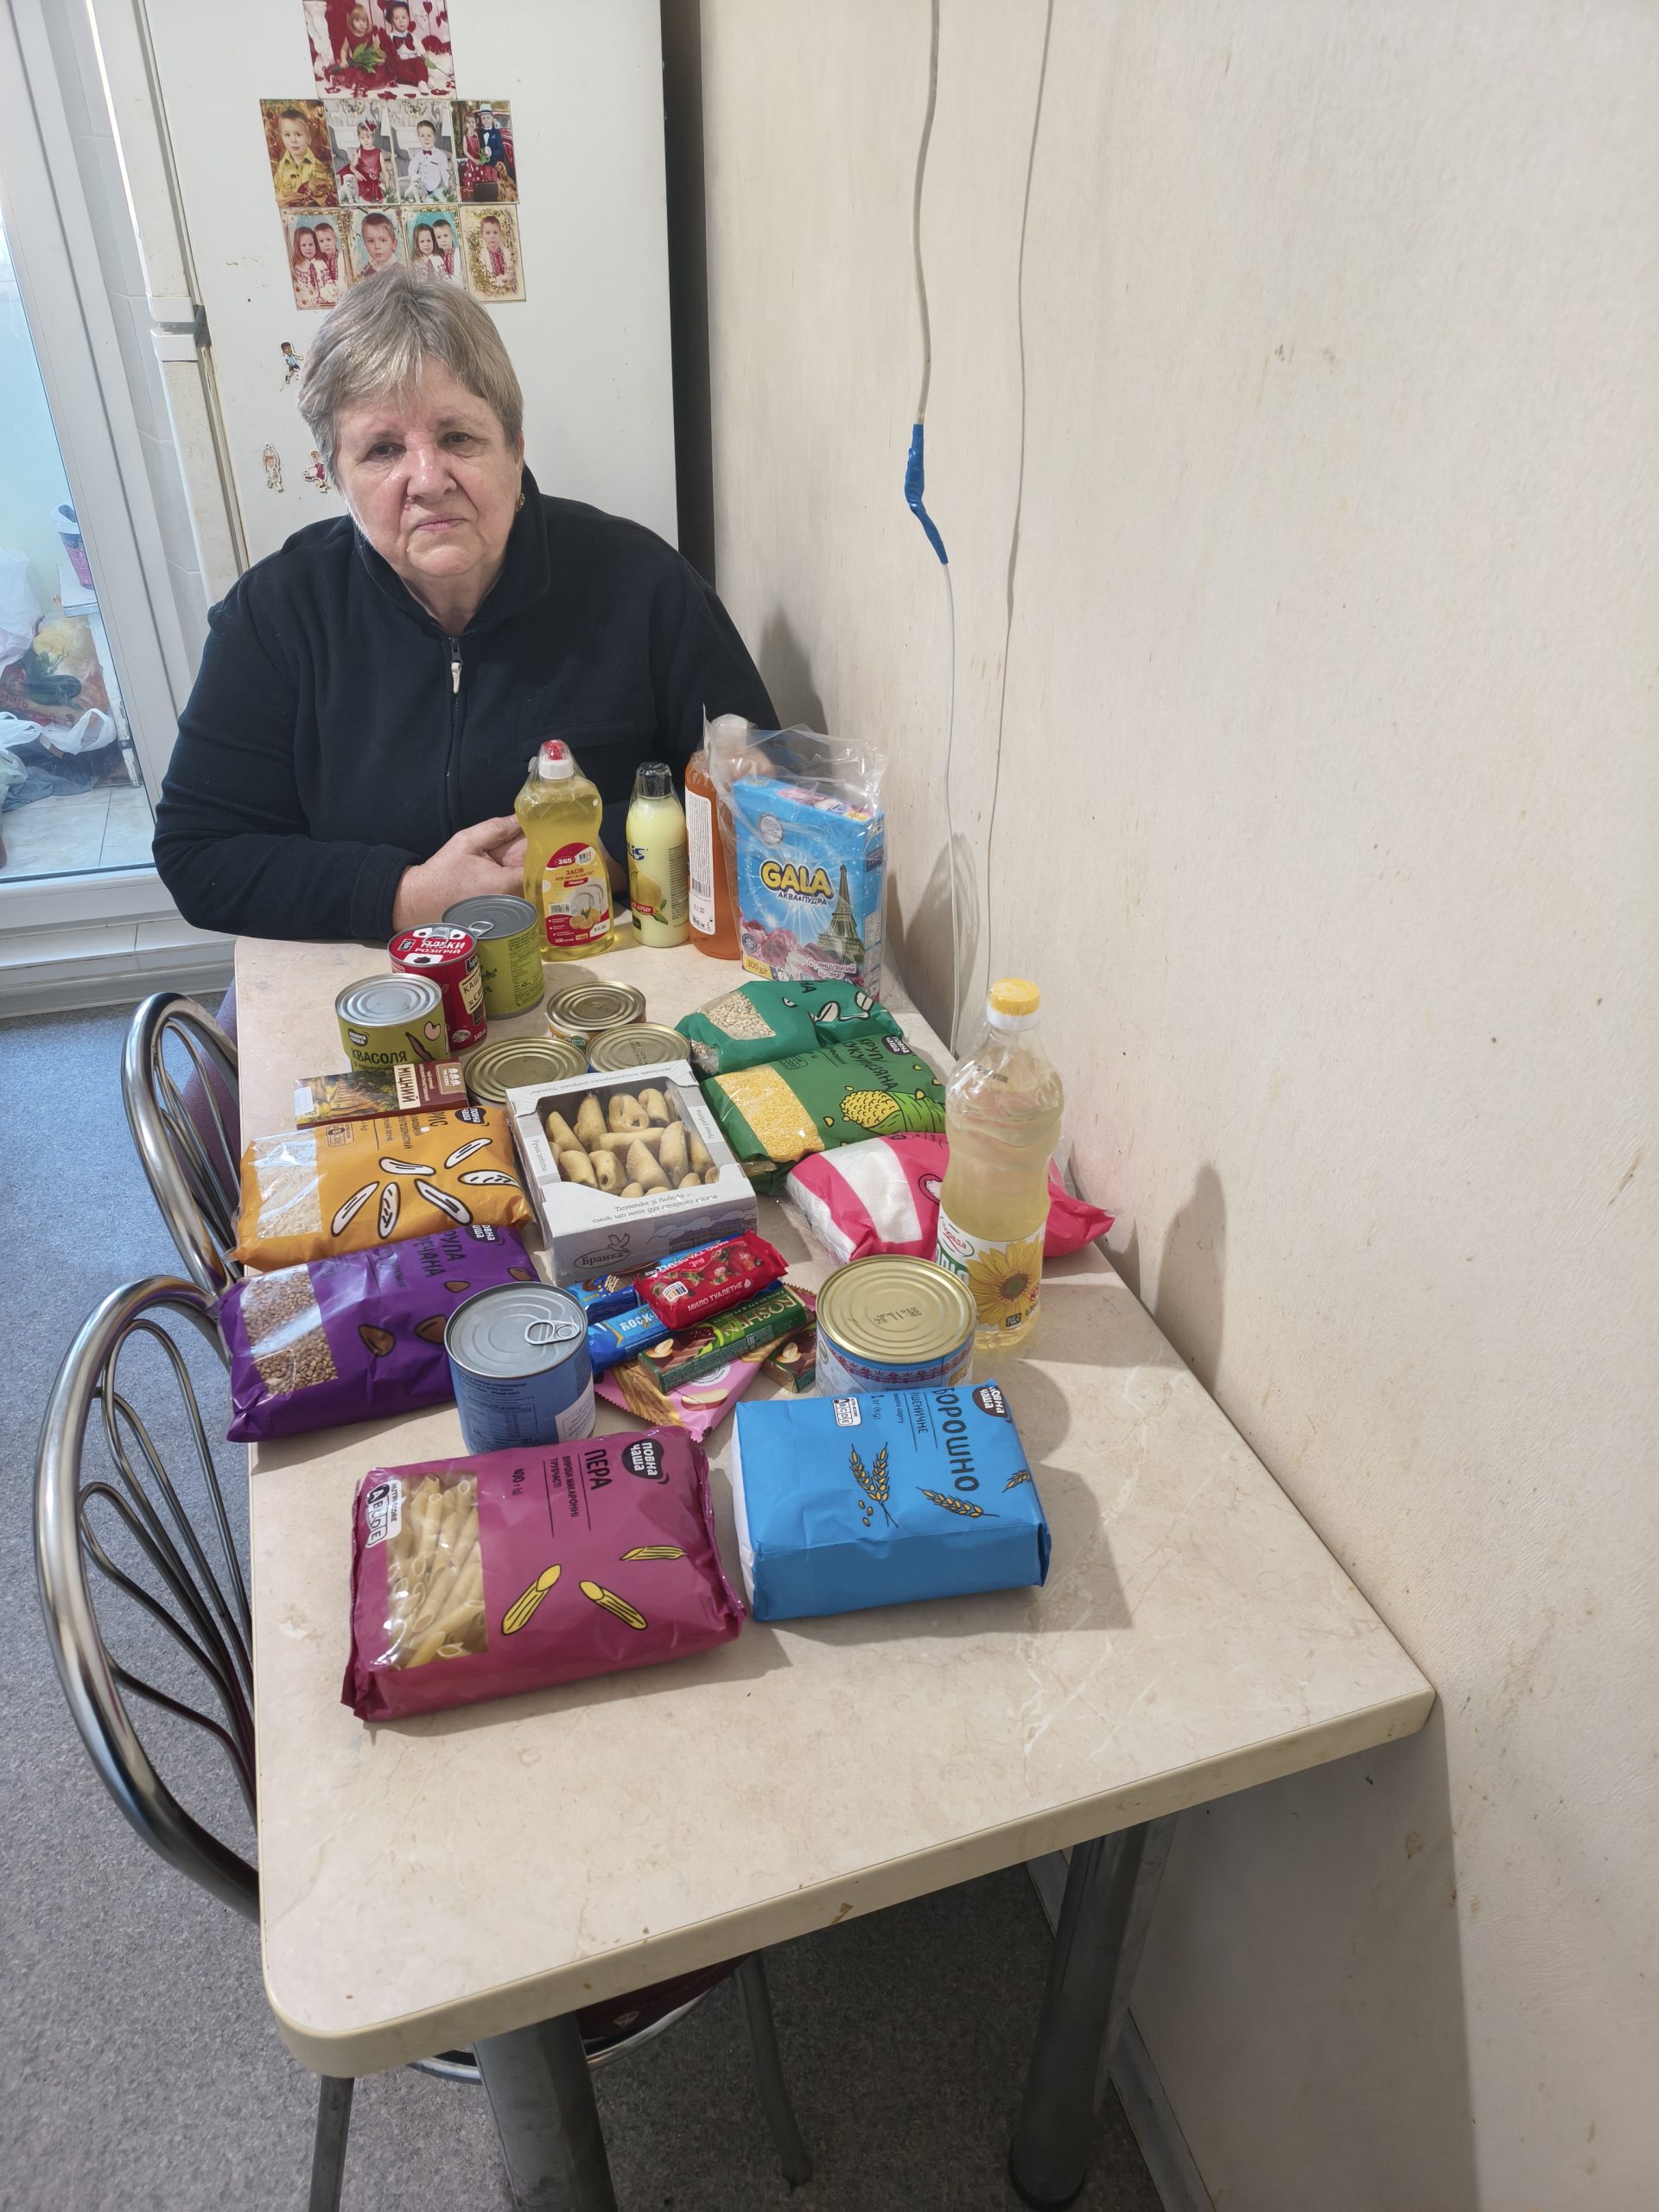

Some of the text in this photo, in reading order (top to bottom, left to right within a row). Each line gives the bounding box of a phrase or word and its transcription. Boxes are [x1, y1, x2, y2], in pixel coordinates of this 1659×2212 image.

[565, 867, 585, 876] ЗАСІБ
[760, 861, 835, 899] GALA
[778, 892, 827, 906] АКВА ПУДРА
[747, 959, 759, 971] 300
[807, 959, 856, 973] Французький
[352, 1047, 408, 1065] КВАСОЛЯ
[397, 1067, 419, 1103] МІЦНИЙ
[614, 1200, 649, 1212] Тісточка
[472, 1224, 485, 1239] аша
[482, 1224, 496, 1241] овна
[414, 1236, 446, 1278] РЕЧАНА
[440, 1230, 467, 1262] РУПА
[582, 1251, 624, 1266] Бранка
[688, 1298, 709, 1312] МИЛО
[709, 1281, 744, 1302] ТУАЛЕТНЕ
[723, 1295, 797, 1336] ROSHEN
[980, 1389, 995, 1409] чаша
[630, 1444, 645, 1471] чаша
[641, 1442, 658, 1476] повна
[512, 1468, 524, 1484] 400
[550, 1458, 562, 1489] ТРУБЧАСТІ
[584, 1448, 613, 1491] ПЕРА
[567, 1478, 580, 1518] МАКАРОННІ
